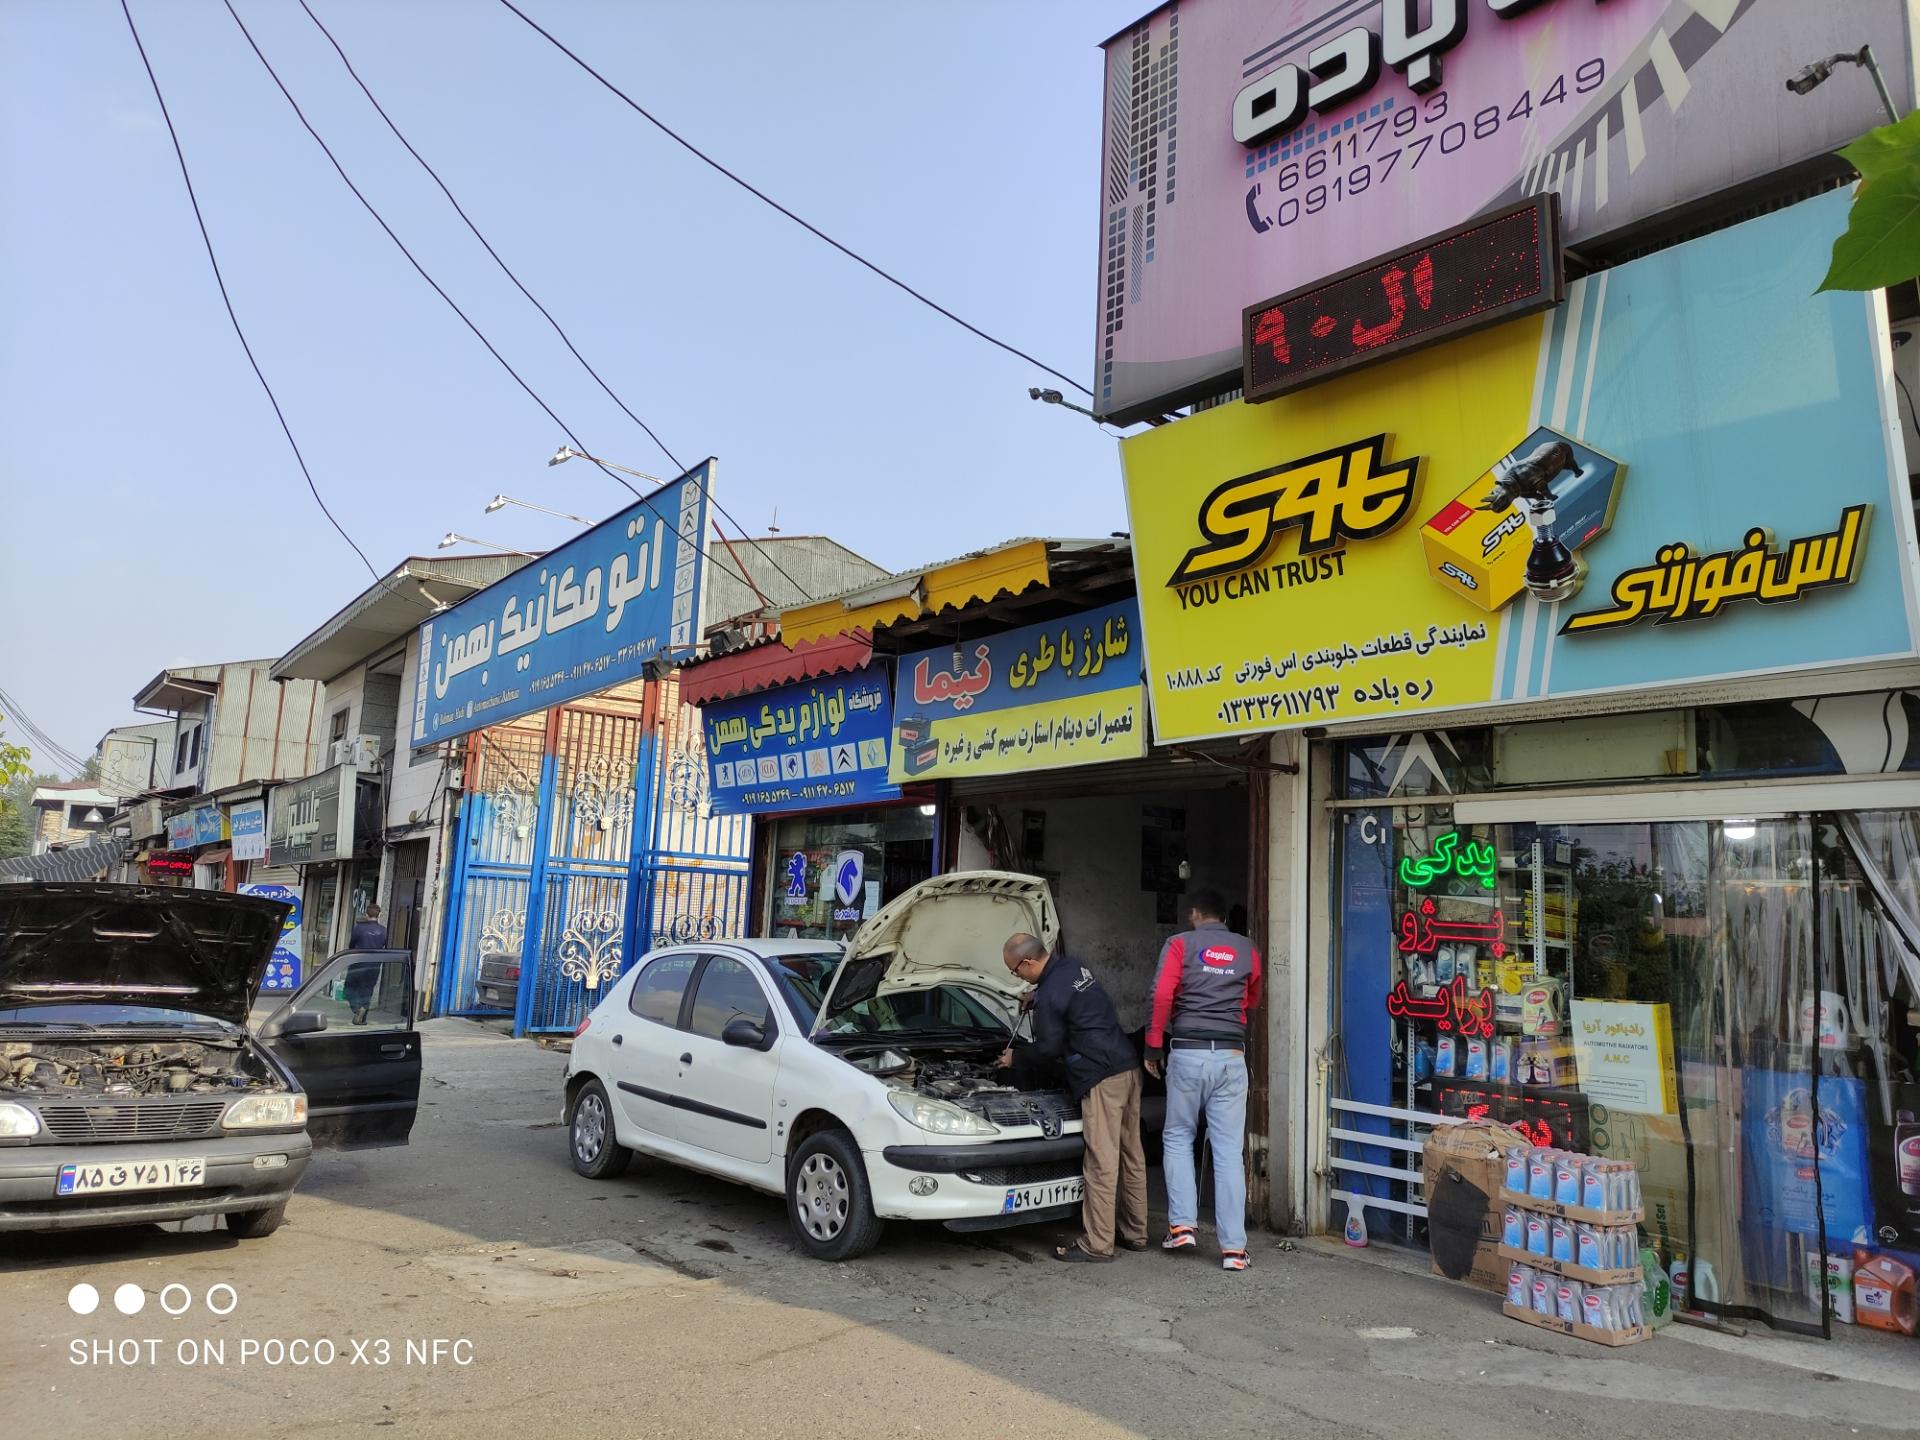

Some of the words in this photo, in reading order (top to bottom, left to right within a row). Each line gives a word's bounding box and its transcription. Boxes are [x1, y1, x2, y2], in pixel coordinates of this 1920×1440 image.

[1277, 90, 1450, 192] 6611793
[1277, 57, 1607, 227] 09197708449
[1175, 581, 1221, 611] YOU
[1224, 571, 1269, 602] CAN
[1271, 549, 1348, 594] TRUST
[1078, 615, 1129, 677] شارژ
[1361, 633, 1413, 659] قطعات
[1415, 622, 1486, 653] نمایندگی
[434, 619, 495, 700] بهمن
[1234, 656, 1272, 684] فورتی
[1275, 652, 1297, 678] اس
[1302, 643, 1358, 671] جلوبندی
[912, 643, 993, 712] نیما
[1166, 667, 1203, 690] ۱۰۸۸۸
[1205, 665, 1222, 683] کد
[1404, 677, 1434, 701] ره
[1217, 684, 1340, 724] ۰۱۳۳۳۶۱۱۷۹۳
[1353, 677, 1400, 705] باده
[750, 703, 797, 750] یدکی
[800, 687, 846, 745] لوازم
[1086, 707, 1133, 747] تعمیرات
[709, 710, 748, 755] بهمن
[972, 729, 998, 761] کشی
[998, 728, 1017, 752] سیم
[1018, 721, 1054, 755] استارت
[1053, 718, 1083, 747] دینام
[943, 734, 964, 766] غیره
[1401, 831, 1496, 887] یدکی
[1398, 899, 1505, 958] پژو
[1387, 974, 1496, 1037] پراید
[1618, 1043, 1649, 1051] RADIATORS
[77, 1168, 104, 1189] ۸۵
[110, 1166, 128, 1186] ق
[134, 1164, 170, 1184] ۷۵۱
[1014, 1190, 1030, 1208] ۵۹
